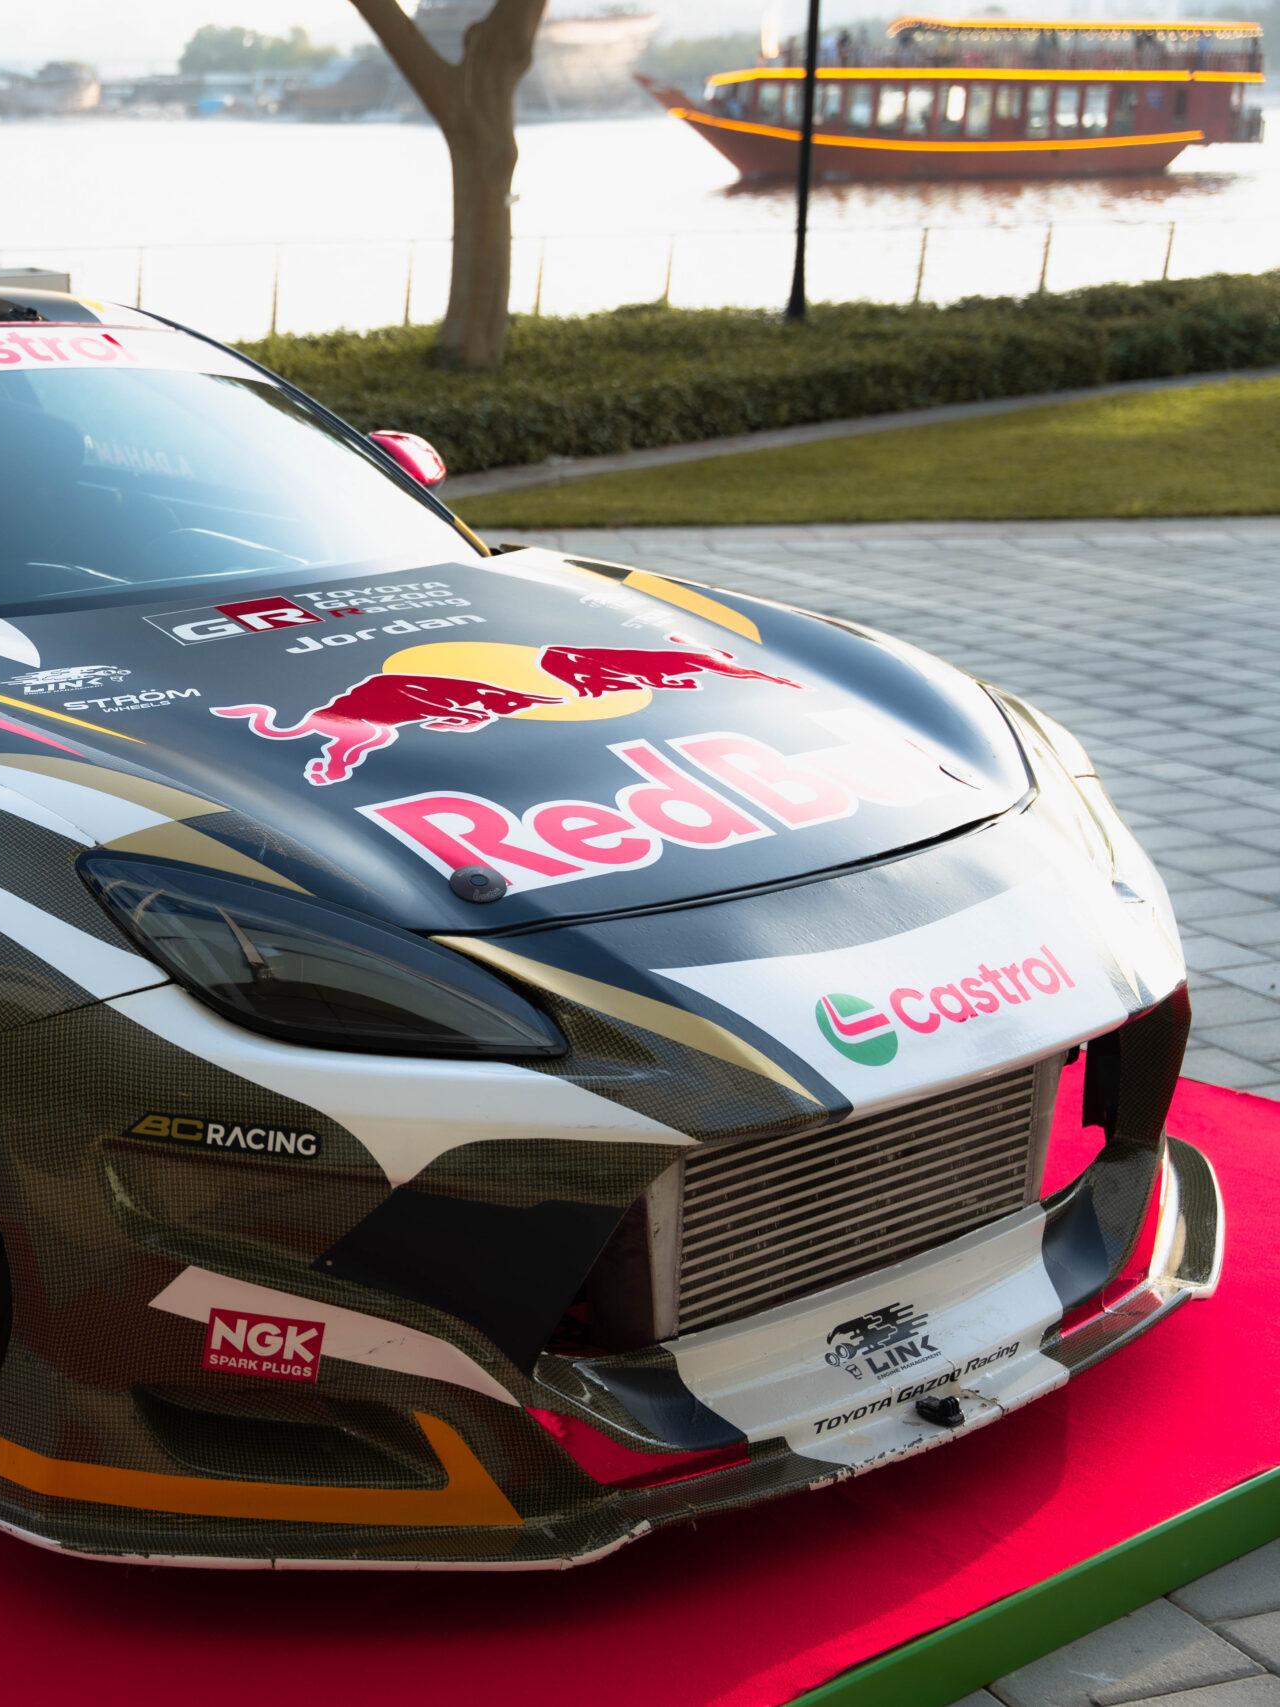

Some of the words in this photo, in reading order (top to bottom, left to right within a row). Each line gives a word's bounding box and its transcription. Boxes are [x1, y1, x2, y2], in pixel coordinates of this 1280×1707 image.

[294, 581, 451, 602] TOYOTA
[313, 590, 454, 610] GAZOO
[327, 598, 472, 618] Racing
[172, 606, 311, 641] GR
[286, 614, 487, 654] Jordan
[63, 688, 202, 711] STRÖM
[102, 700, 171, 713] WHEELS
[889, 944, 1076, 1034] Castrol
[210, 1315, 319, 1363] NGK
[209, 1354, 259, 1371] SPARK
[262, 1361, 312, 1377] PLUGS
[865, 1334, 939, 1374] LINK
[901, 1351, 942, 1370] MANAGEMENT
[814, 1396, 892, 1434] TOYOTA
[964, 1341, 1020, 1375] Racing
